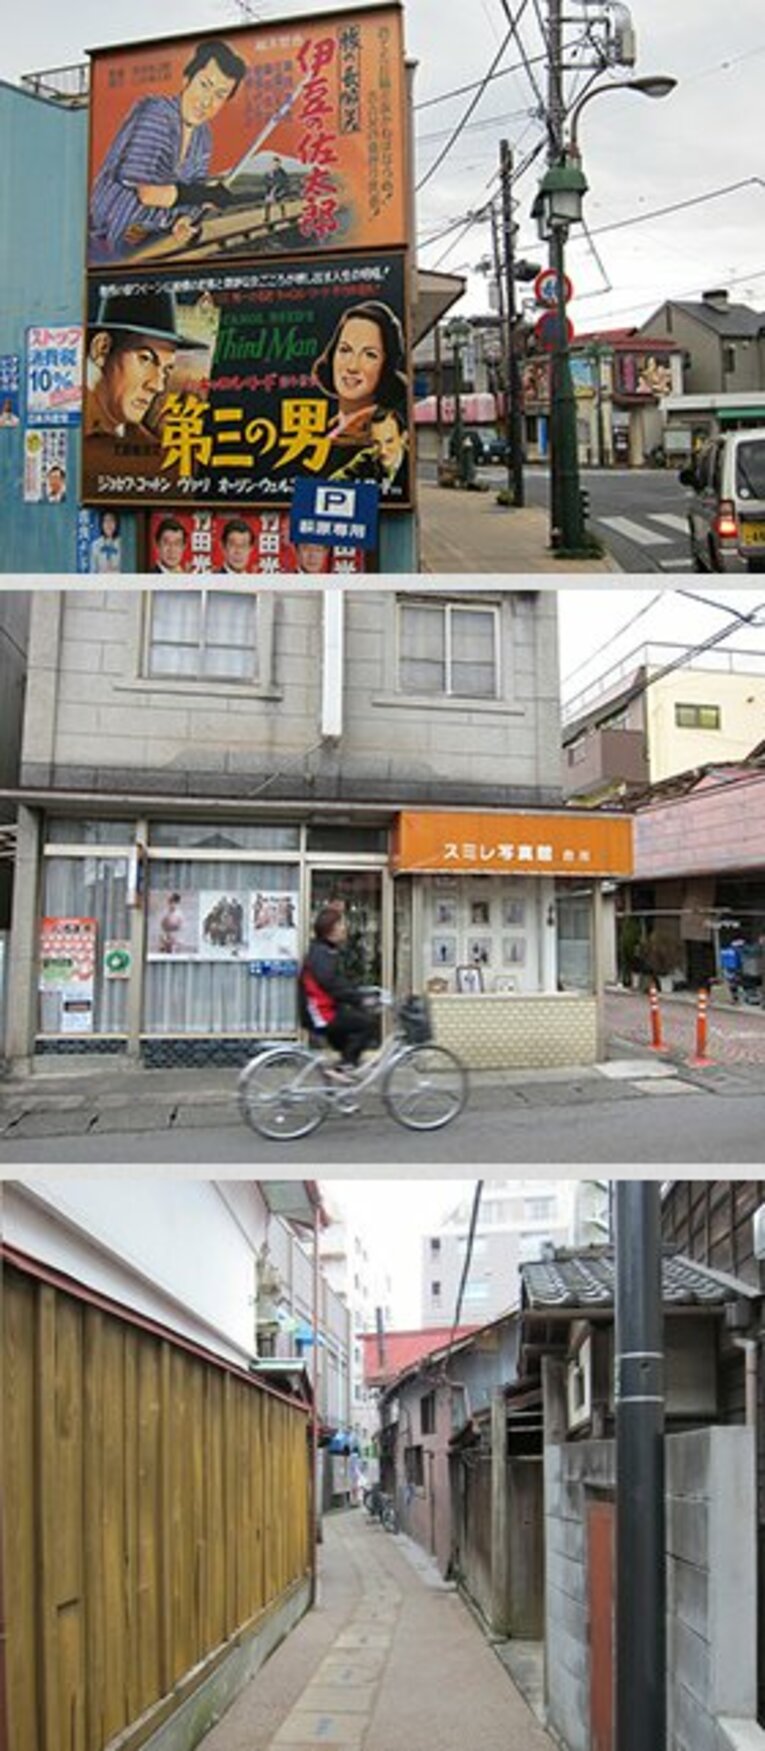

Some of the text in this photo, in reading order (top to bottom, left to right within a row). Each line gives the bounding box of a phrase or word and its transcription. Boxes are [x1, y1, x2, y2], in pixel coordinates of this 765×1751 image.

[298, 37, 339, 240] 伊豆の佐太郎
[30, 368, 74, 392] 10%
[160, 393, 333, 477] 第三の男
[323, 491, 347, 512] P
[443, 842, 553, 862] スミレ写真館
